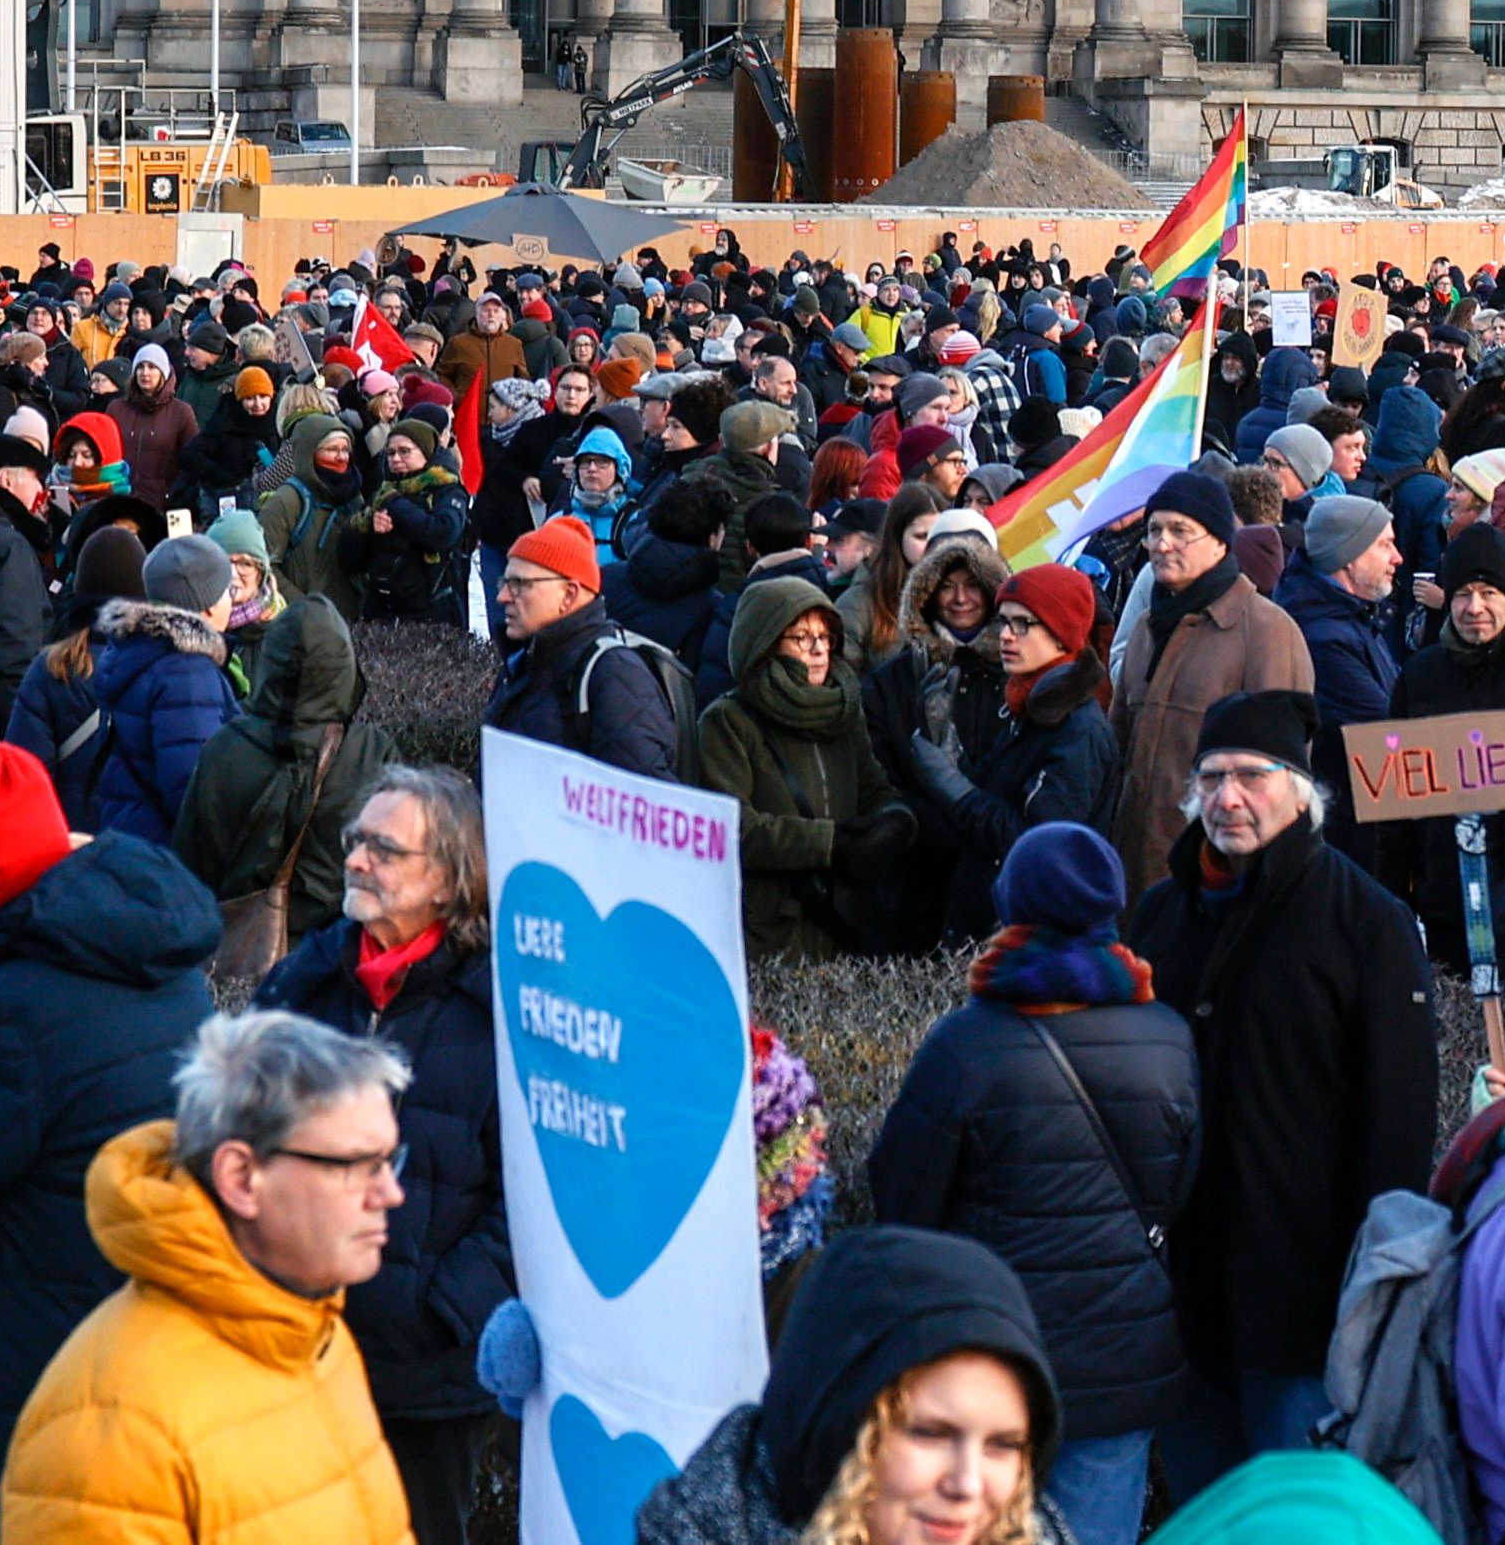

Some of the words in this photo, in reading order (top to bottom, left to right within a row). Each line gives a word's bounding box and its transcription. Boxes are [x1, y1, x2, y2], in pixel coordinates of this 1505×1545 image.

[673, 80, 694, 95] ATLAS
[140, 151, 161, 161] LB
[164, 151, 186, 161] 36
[562, 775, 727, 863] WELTFRIEDEN
[519, 983, 622, 1063] FRIEDEN
[528, 1074, 627, 1153] FREIHEIT
